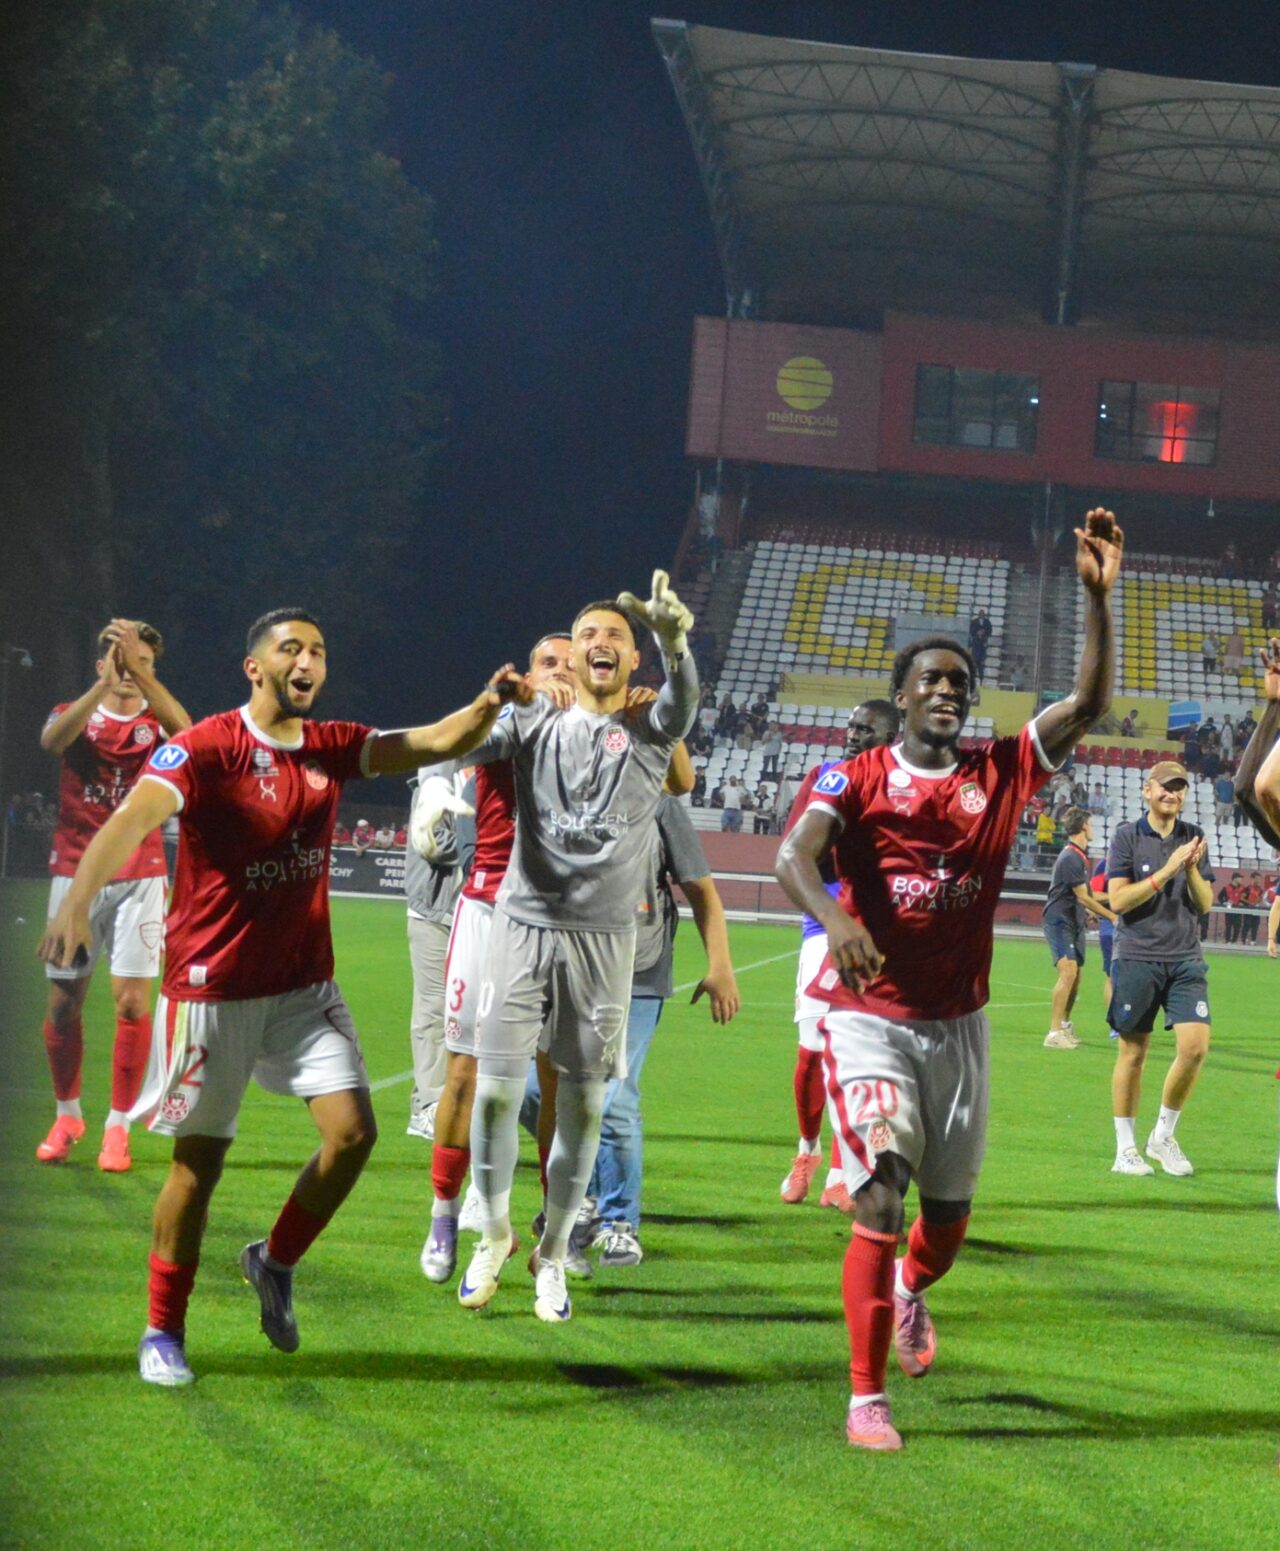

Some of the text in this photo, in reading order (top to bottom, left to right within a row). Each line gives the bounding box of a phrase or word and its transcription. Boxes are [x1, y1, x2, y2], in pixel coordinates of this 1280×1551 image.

[160, 748, 179, 763] N
[823, 774, 839, 788] N
[246, 848, 325, 879] BOUSEN
[375, 857, 406, 867] CARR
[892, 875, 983, 899] BOUTSEN
[891, 895, 978, 911] AVIATIO
[450, 978, 466, 1012] 3
[180, 1044, 209, 1087] 2
[852, 1079, 899, 1125] 20
